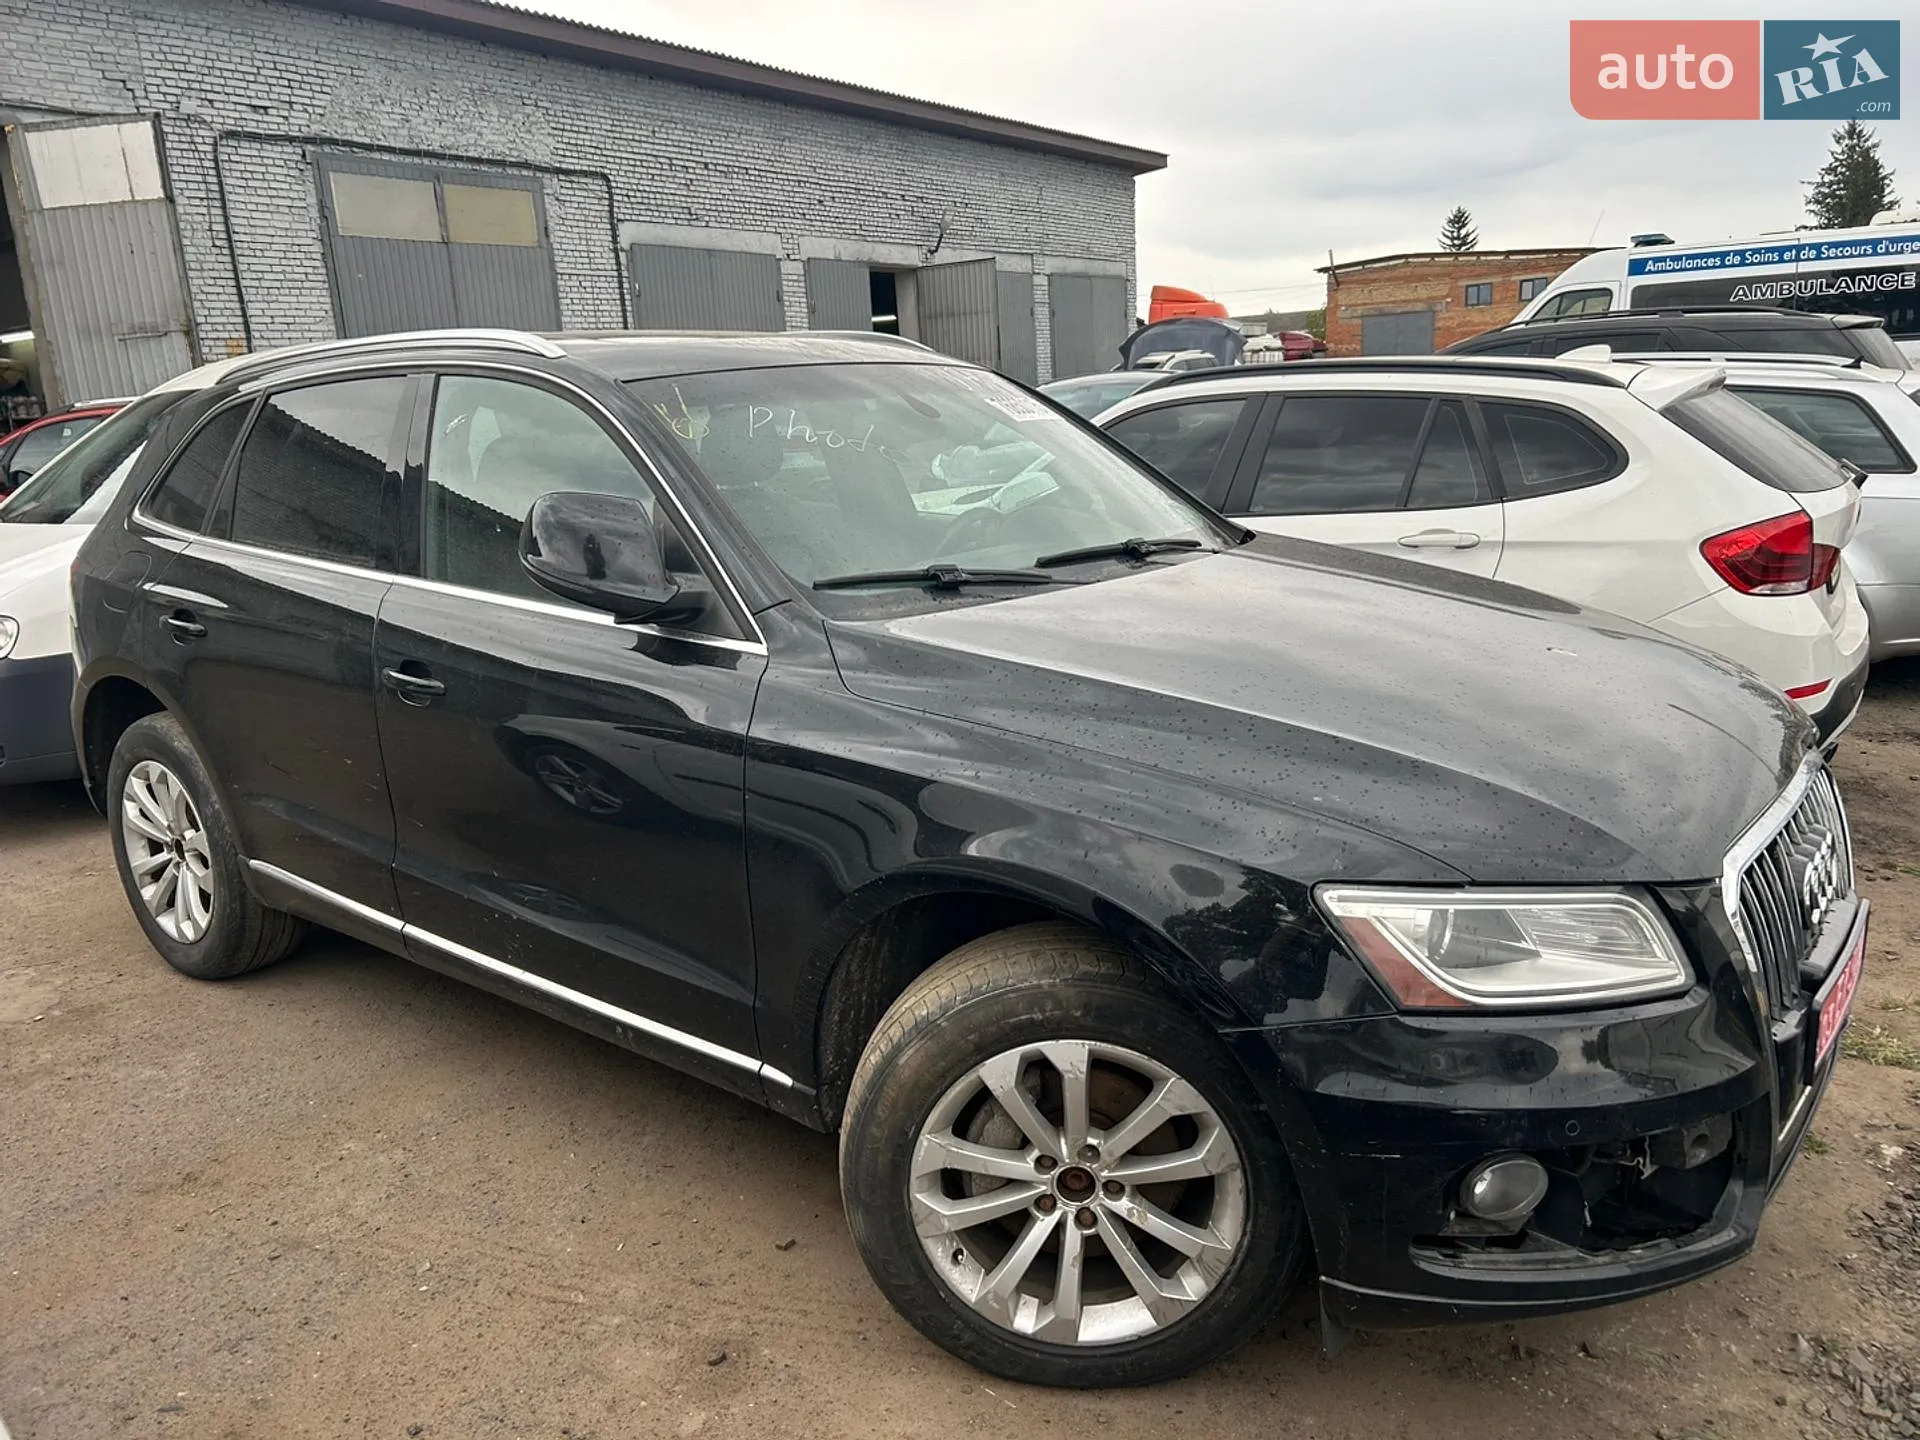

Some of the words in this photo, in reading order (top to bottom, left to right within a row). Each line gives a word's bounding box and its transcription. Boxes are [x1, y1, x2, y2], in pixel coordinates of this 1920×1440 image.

[1645, 256, 1721, 273] Ambulances
[1724, 252, 1741, 265] de
[1745, 249, 1780, 263] Soins
[1783, 248, 1796, 261] et
[1799, 246, 1817, 259] de
[1820, 244, 1873, 258] Secours
[1729, 271, 1917, 302] AMBULANCE
